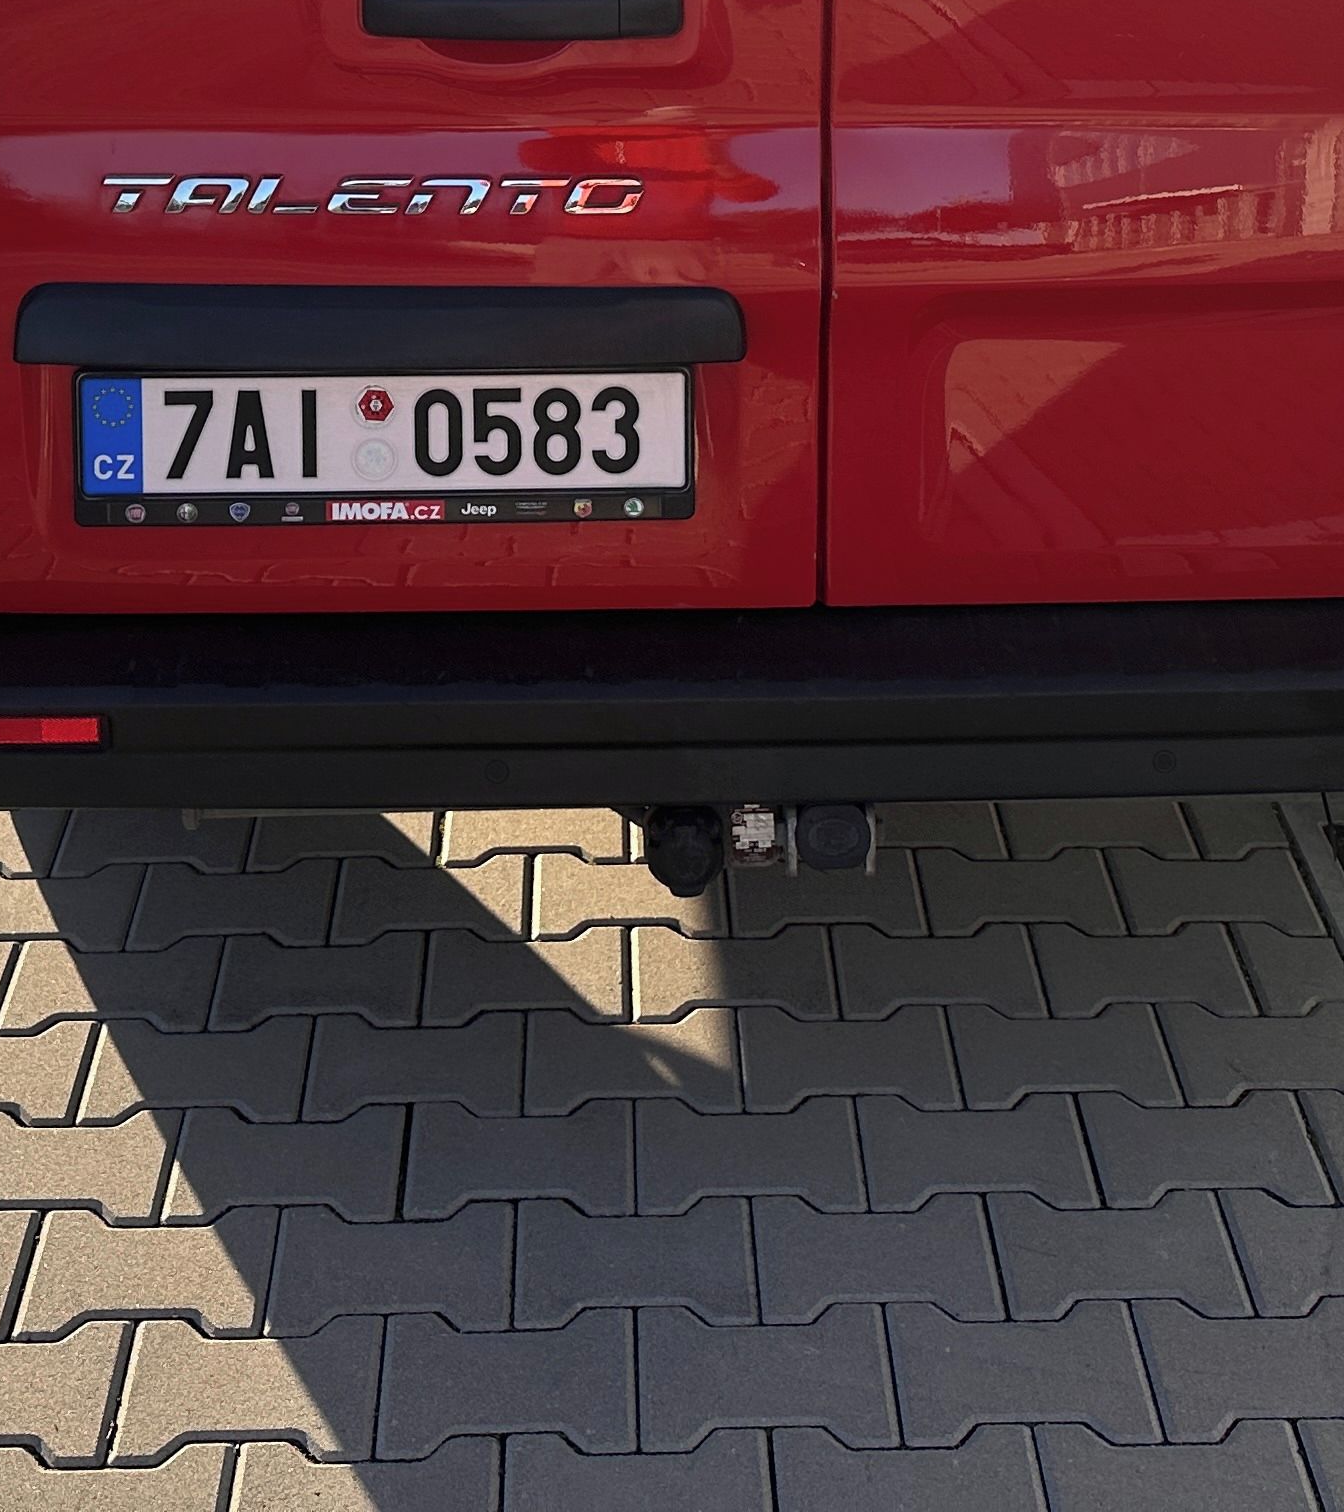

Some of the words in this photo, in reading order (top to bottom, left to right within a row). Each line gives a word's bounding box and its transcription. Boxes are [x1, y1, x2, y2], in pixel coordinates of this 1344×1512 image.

[101, 174, 645, 215] TALENTO
[163, 389, 318, 479] 7AI
[414, 386, 640, 477] 0583
[93, 454, 135, 480] CZ
[461, 503, 497, 517] Jeep
